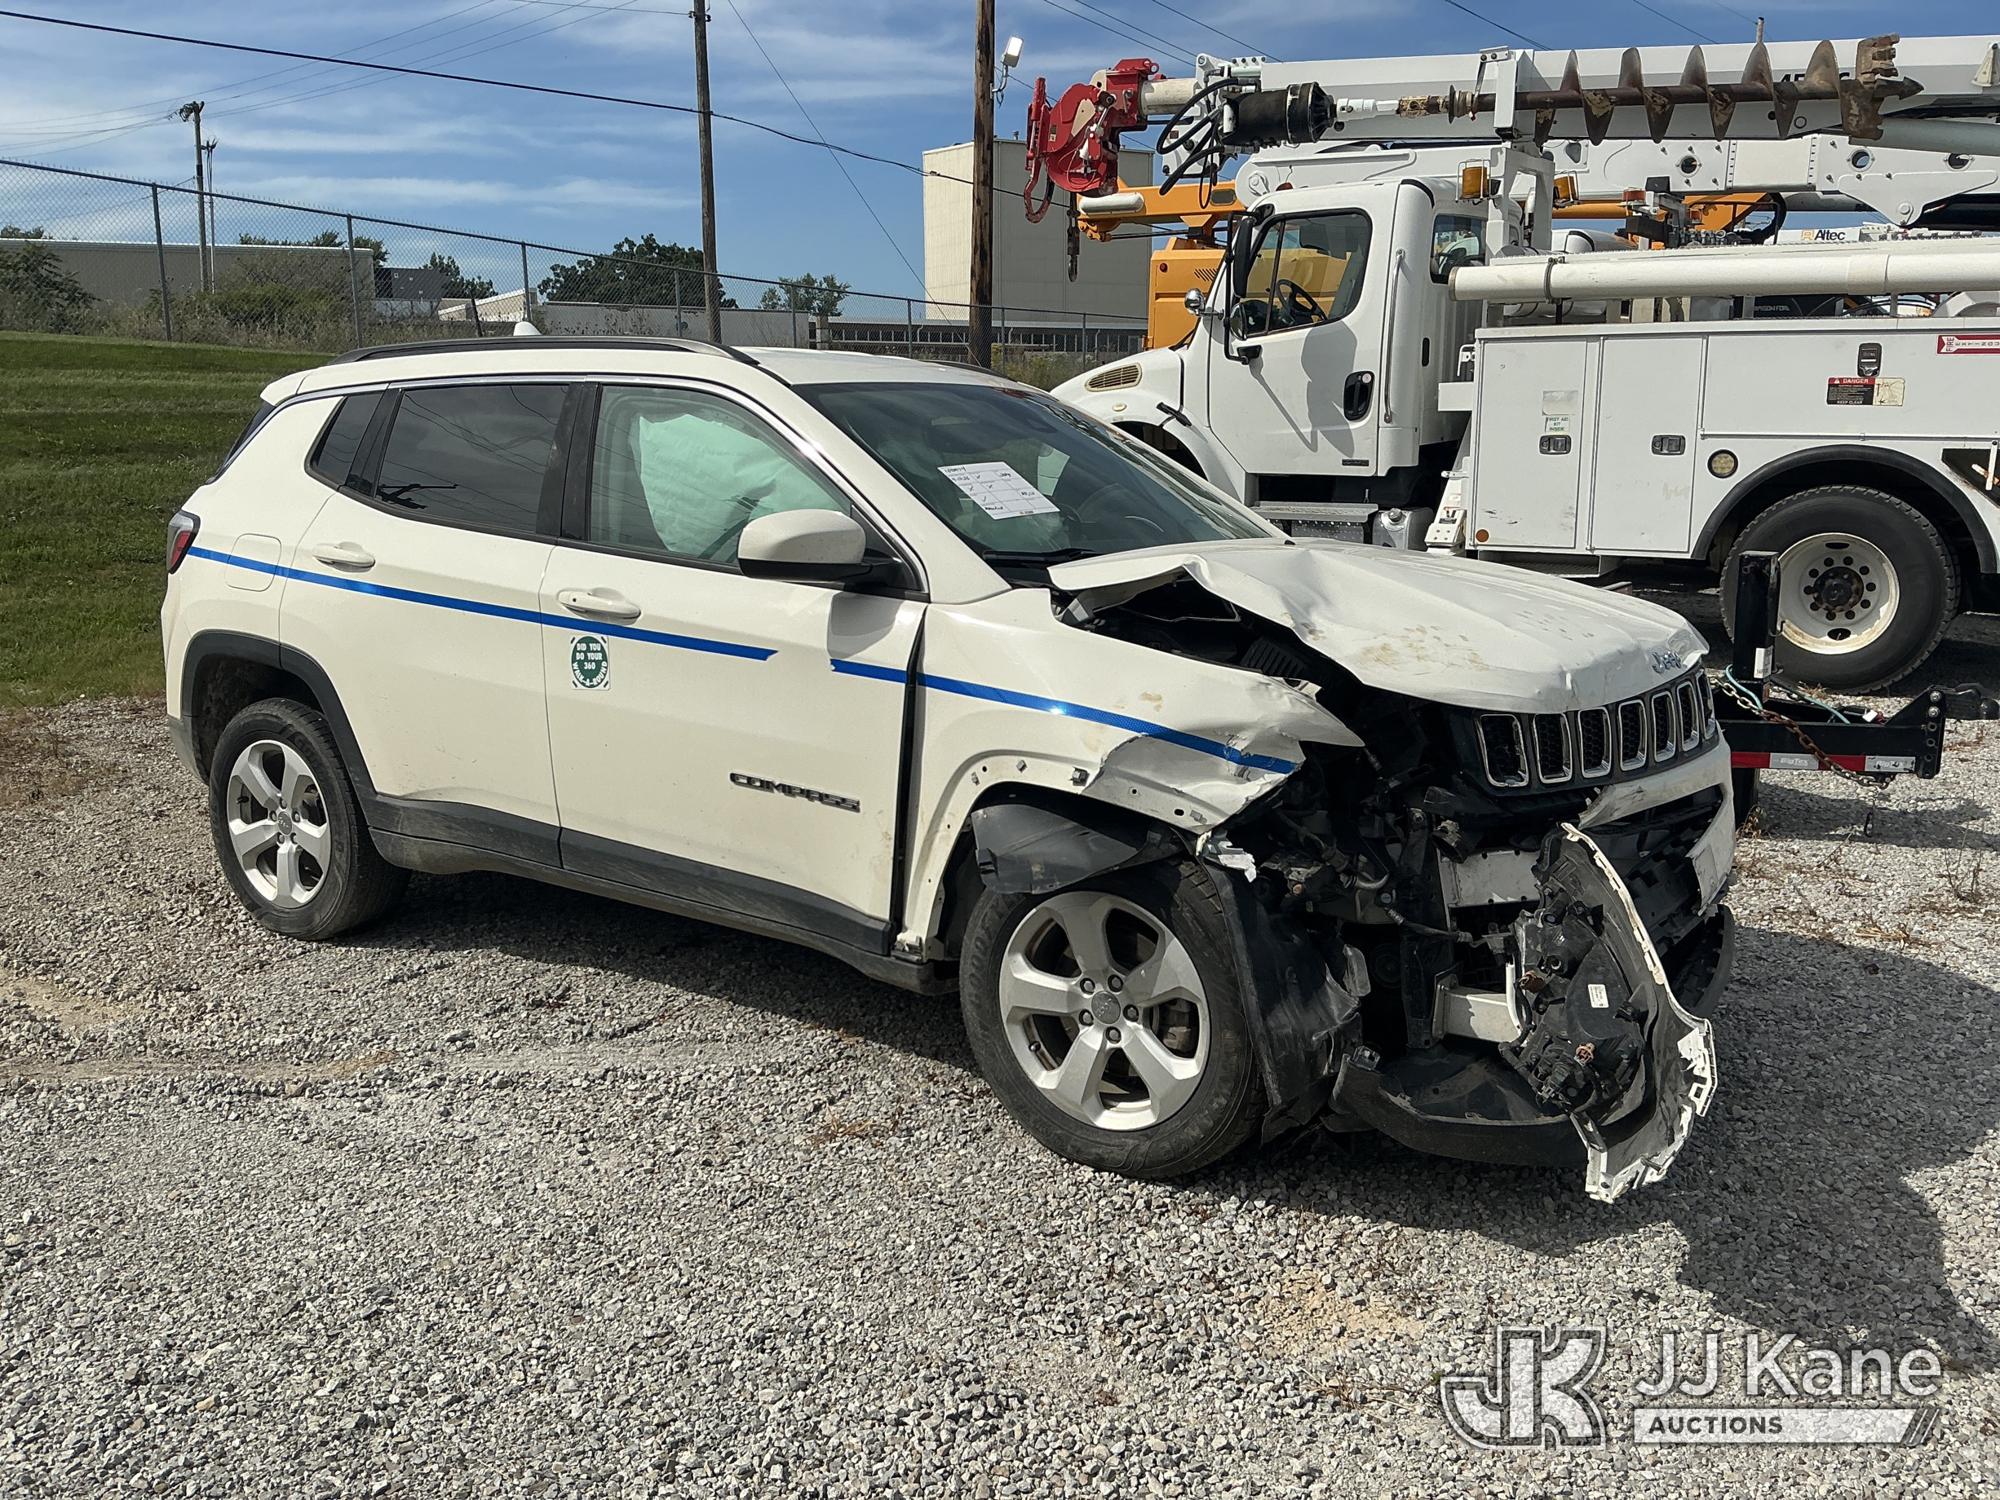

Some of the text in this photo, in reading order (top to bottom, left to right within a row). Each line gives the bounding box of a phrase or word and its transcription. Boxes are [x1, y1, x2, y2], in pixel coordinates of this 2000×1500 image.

[1814, 230, 1846, 241] Altec
[1945, 336, 1955, 352] FIRE
[576, 643, 601, 651] DID YOU
[584, 662, 596, 670] 360
[730, 772, 860, 812] COMPASS
